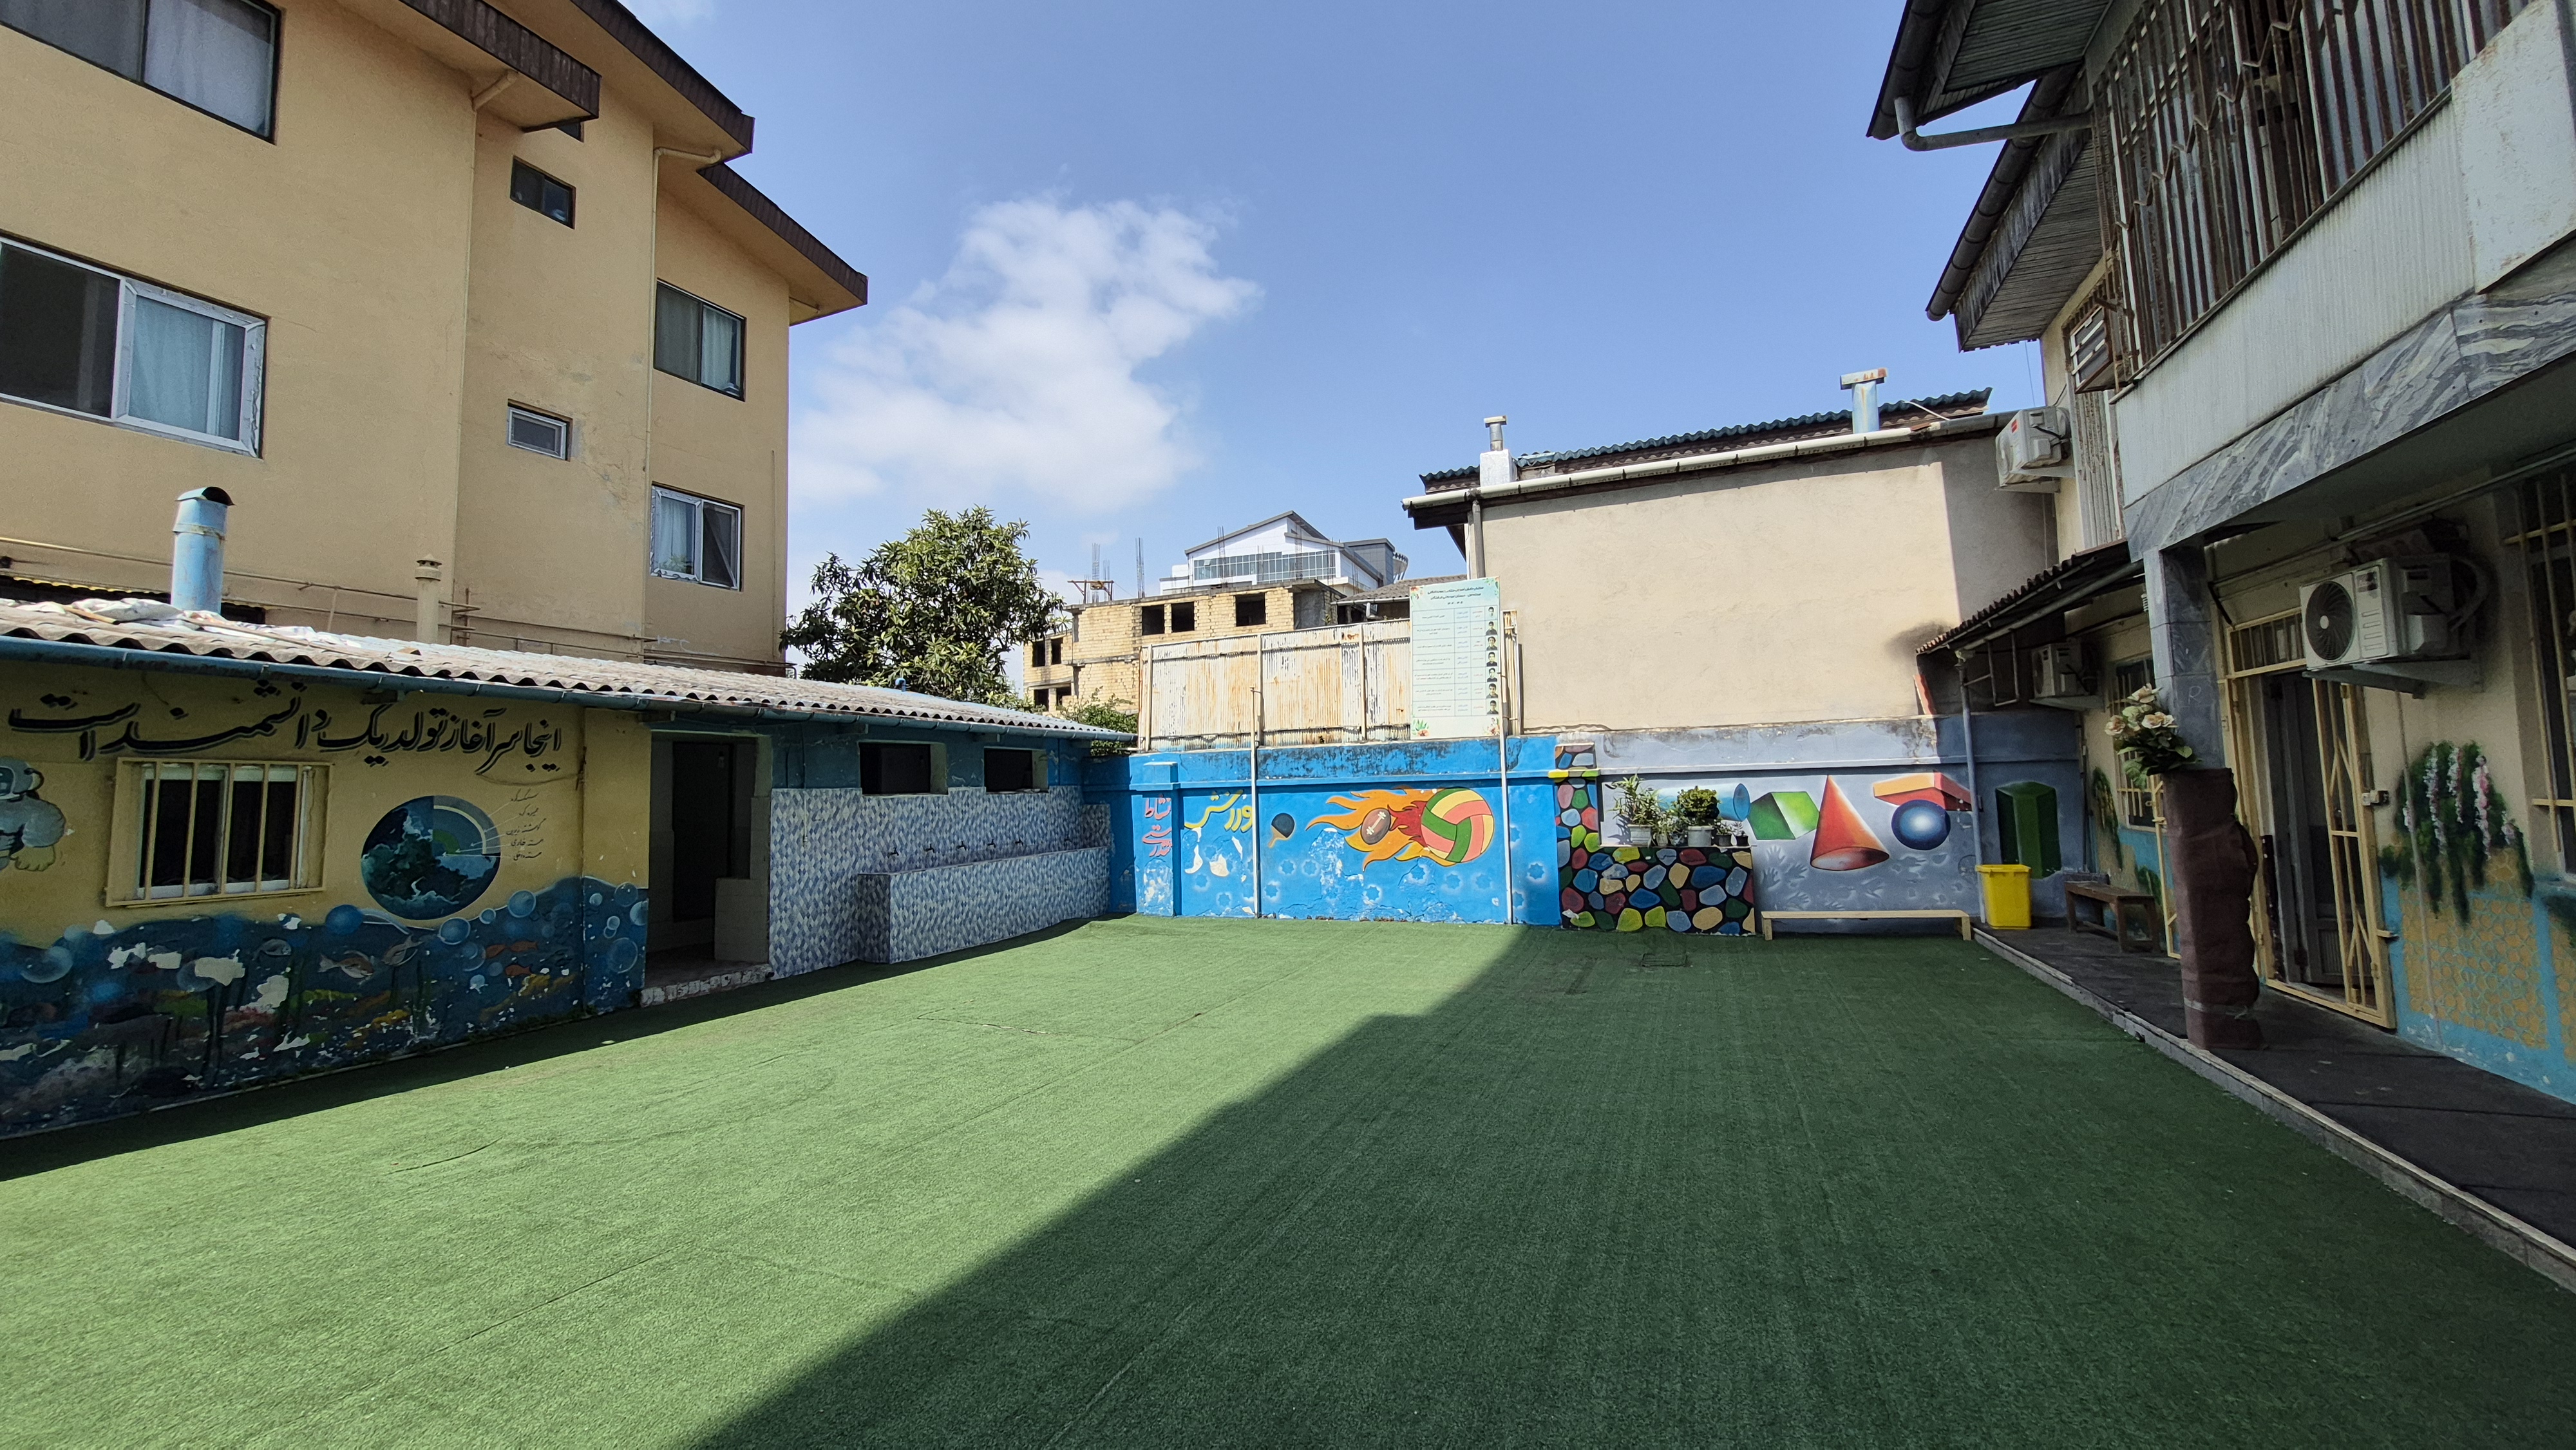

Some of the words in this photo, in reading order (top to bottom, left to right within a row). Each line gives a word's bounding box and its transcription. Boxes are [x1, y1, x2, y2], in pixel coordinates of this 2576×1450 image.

[8, 693, 142, 762] است
[99, 679, 332, 755] دانشمند
[317, 704, 393, 767] یک
[381, 708, 450, 752] تولد
[524, 719, 562, 771] اینجا
[1144, 794, 1171, 820] نشاط
[1184, 789, 1253, 833] ورزش
